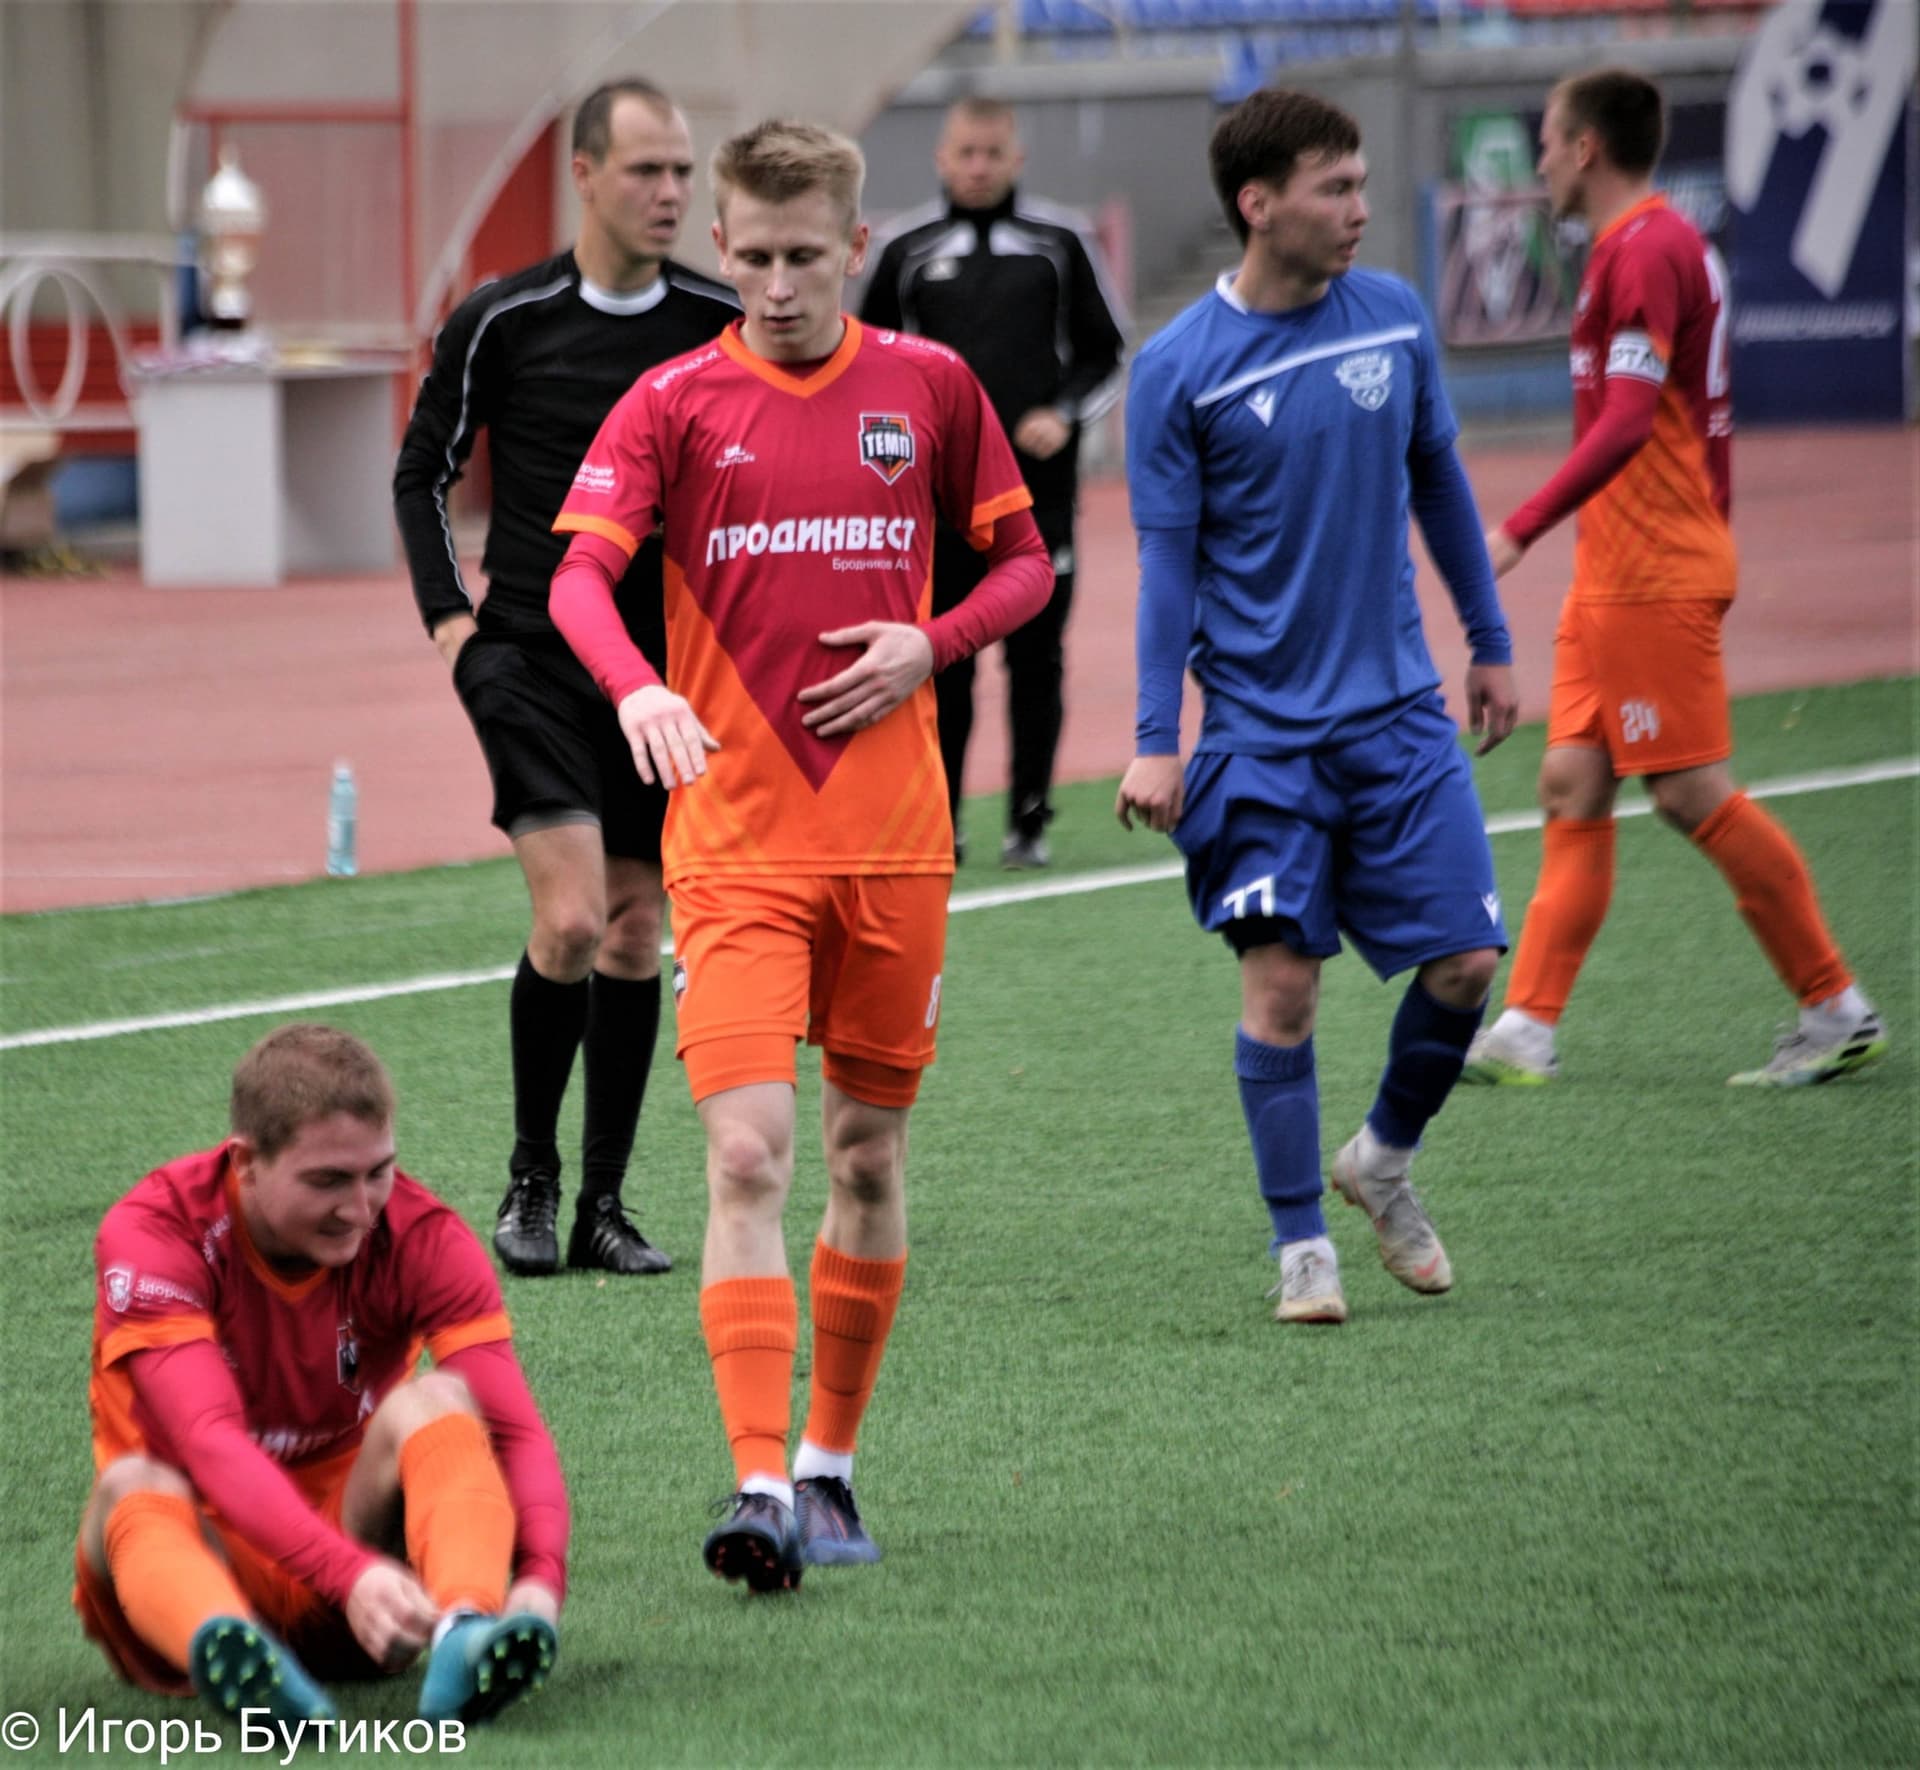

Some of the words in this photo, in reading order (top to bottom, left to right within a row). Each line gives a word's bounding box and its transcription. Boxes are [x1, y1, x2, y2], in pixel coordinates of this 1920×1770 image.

[864, 431, 910, 459] ТЕМП
[705, 516, 915, 567] ПРОДИНВЕСТ
[832, 558, 893, 573] Бродников
[1619, 702, 1658, 743] 24
[924, 974, 942, 1029] 8
